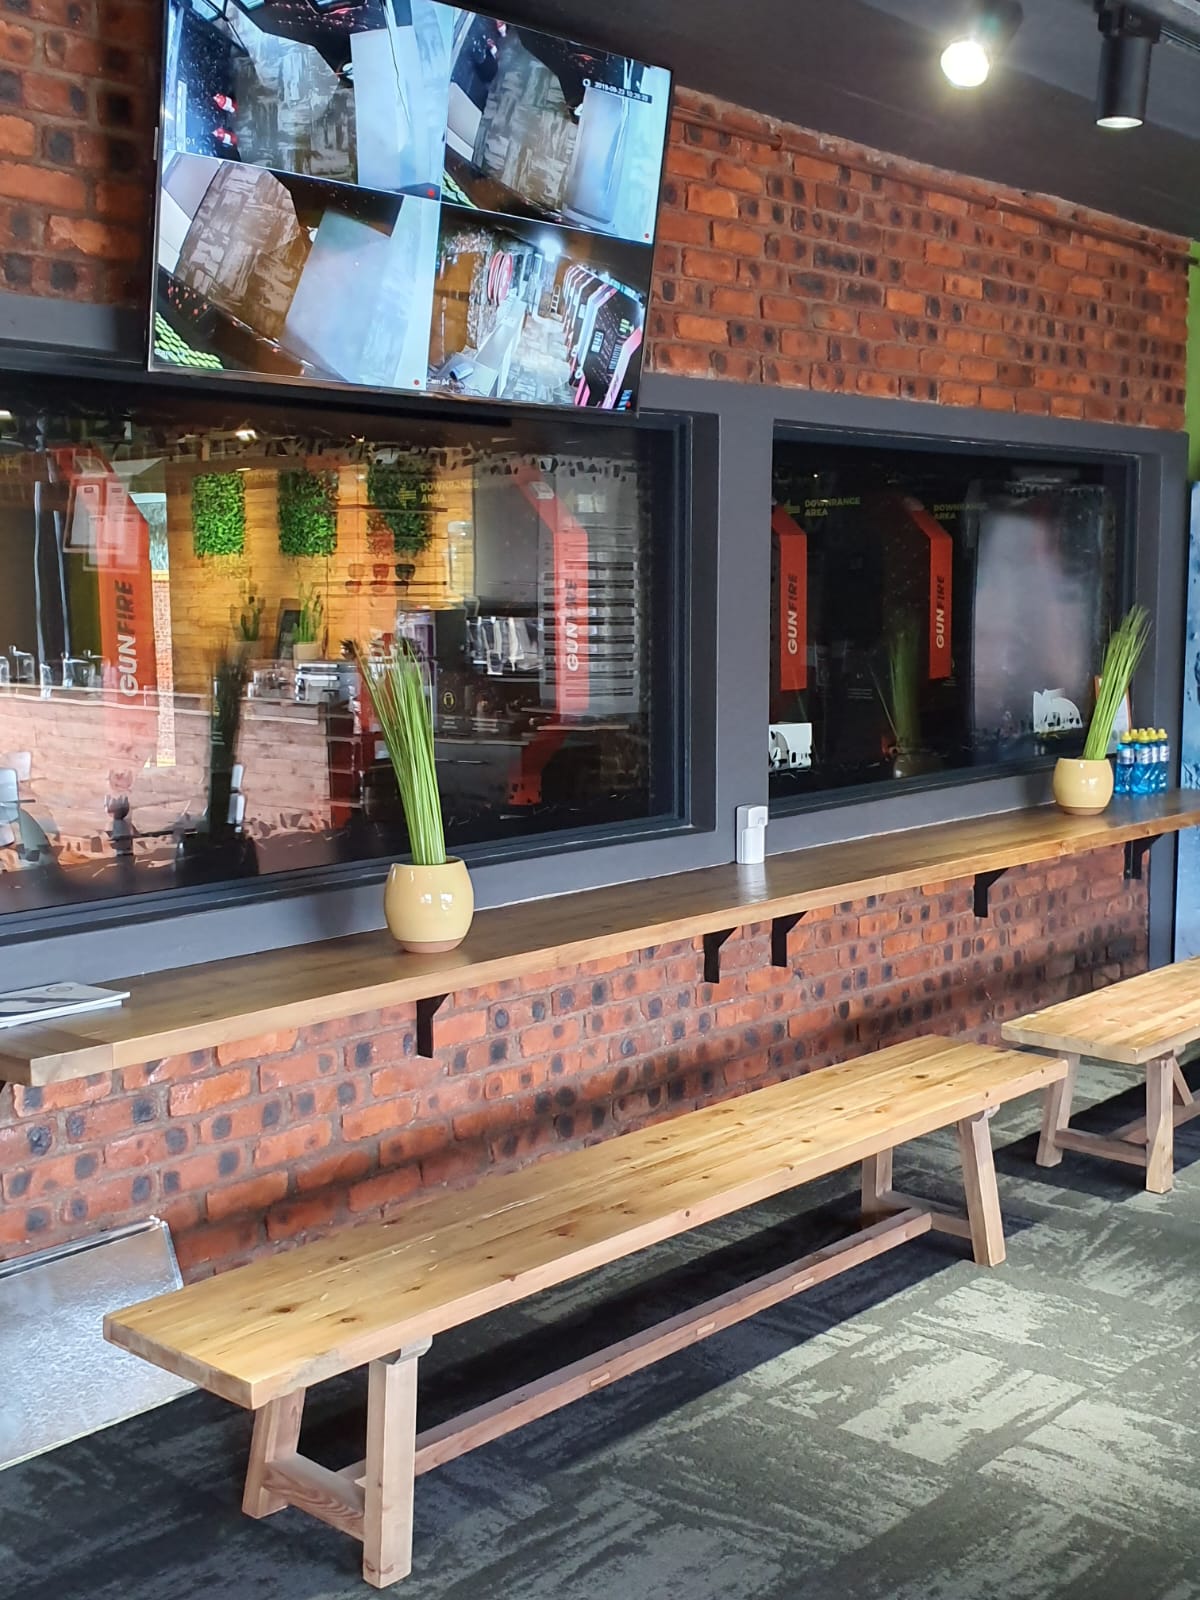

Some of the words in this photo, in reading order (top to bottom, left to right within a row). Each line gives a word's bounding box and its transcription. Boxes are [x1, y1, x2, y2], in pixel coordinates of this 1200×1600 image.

[804, 496, 861, 508] DOWNRANGE
[804, 507, 828, 517] AREA
[114, 579, 139, 697] GUNFIRE
[786, 573, 798, 656] GUNFIRE
[935, 574, 945, 649] GUNFIRE
